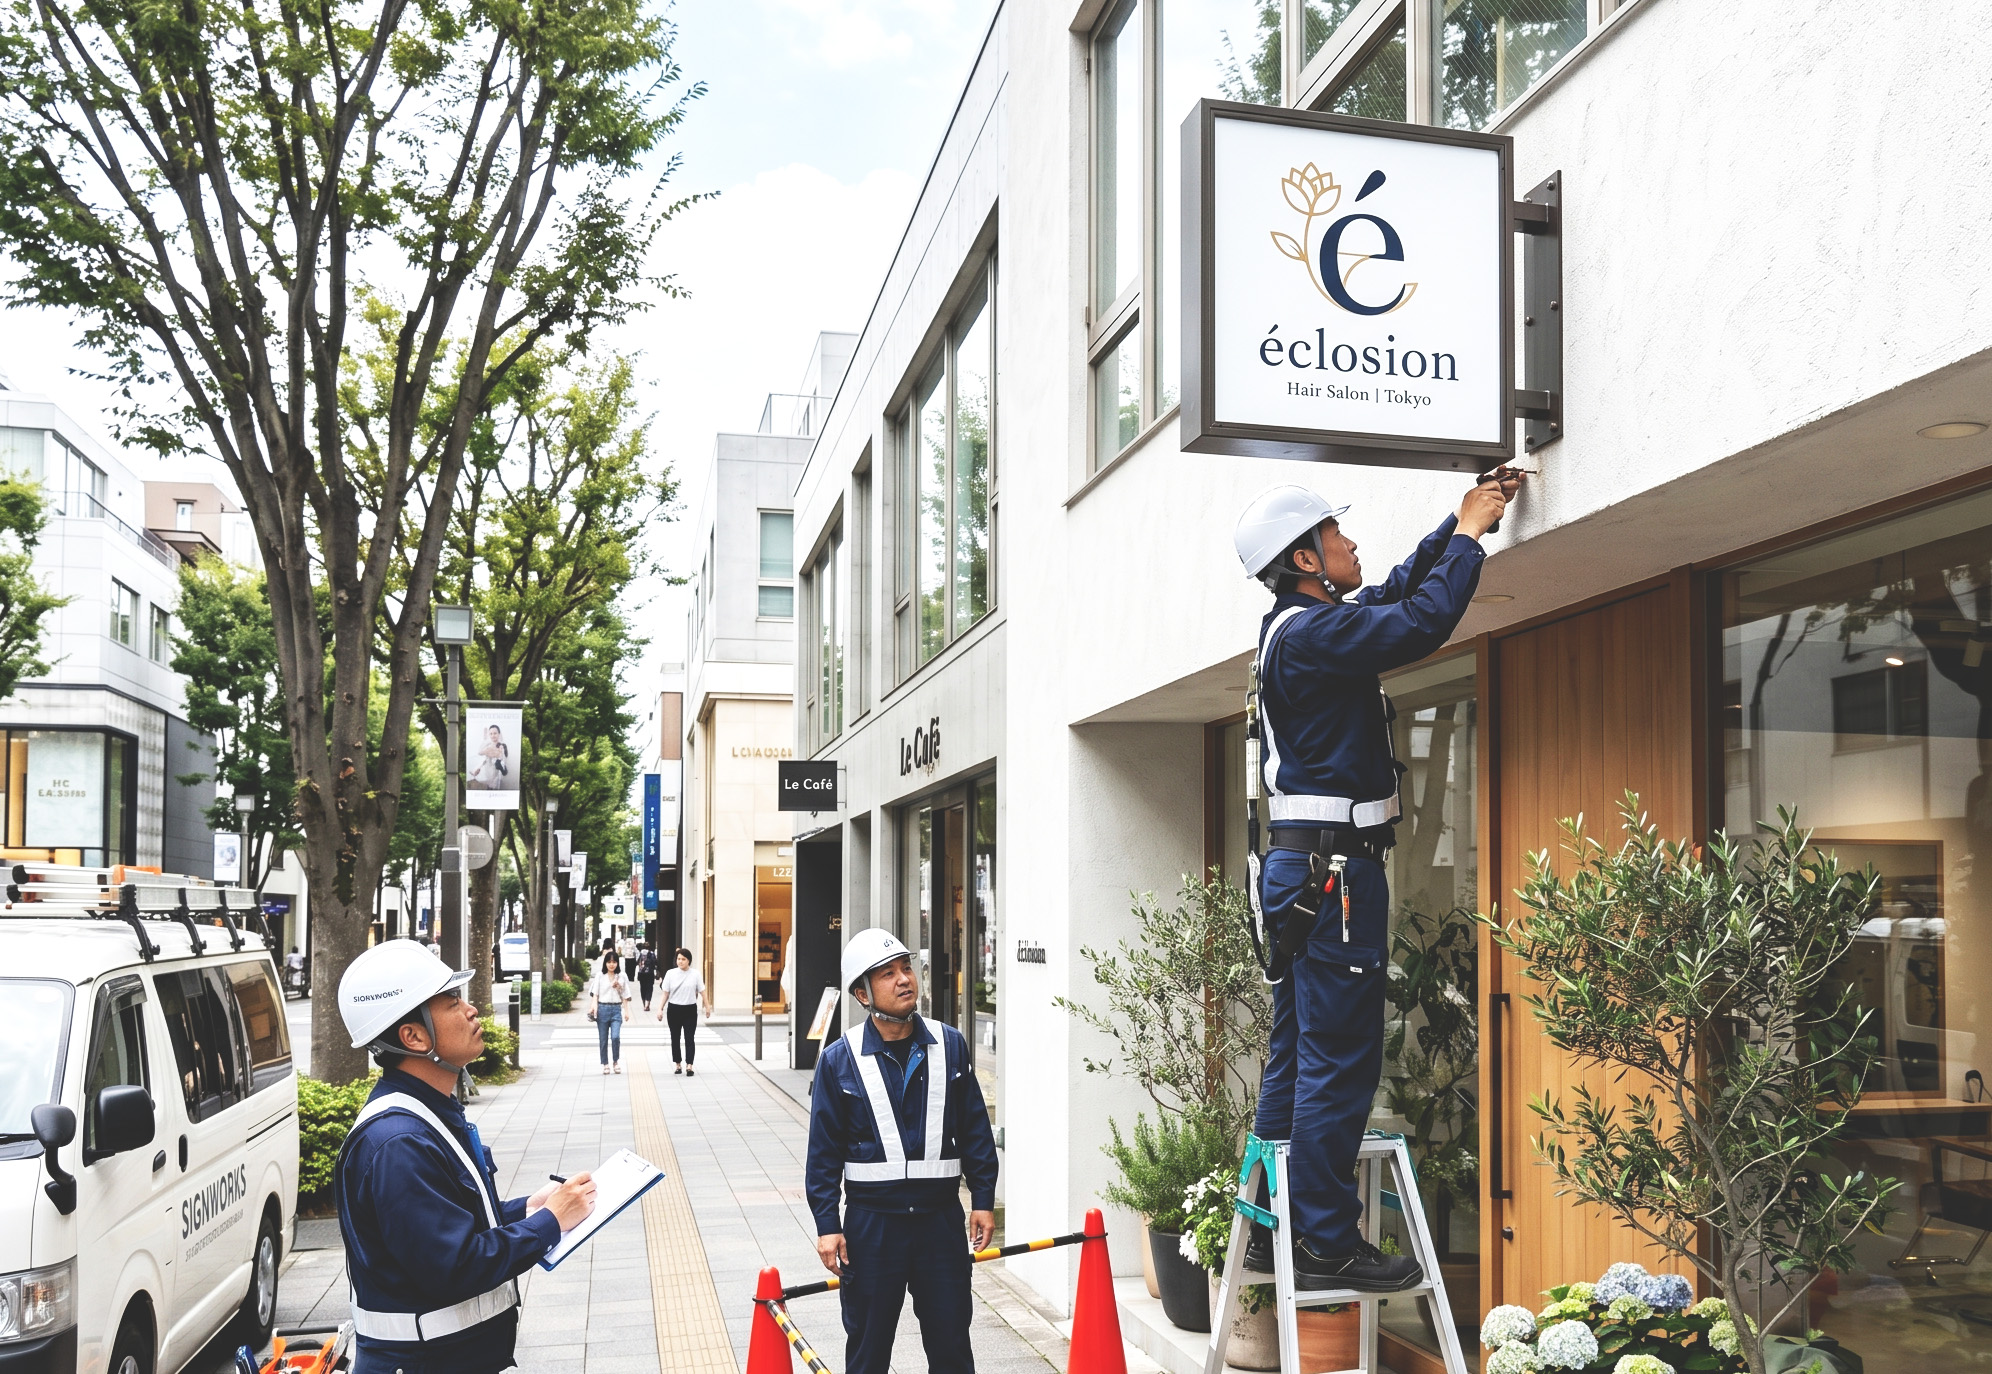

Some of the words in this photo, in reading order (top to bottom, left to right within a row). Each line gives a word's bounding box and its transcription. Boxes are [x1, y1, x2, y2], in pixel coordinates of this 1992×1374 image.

[1259, 323, 1459, 382] éclosion
[1287, 381, 1322, 398] Hair
[1326, 384, 1370, 401] Salon
[1384, 389, 1432, 409] Tokyo
[900, 737, 912, 777] Le
[784, 778, 800, 790] Le
[803, 778, 833, 790] Café
[182, 1163, 247, 1240] SIGNWORKS
